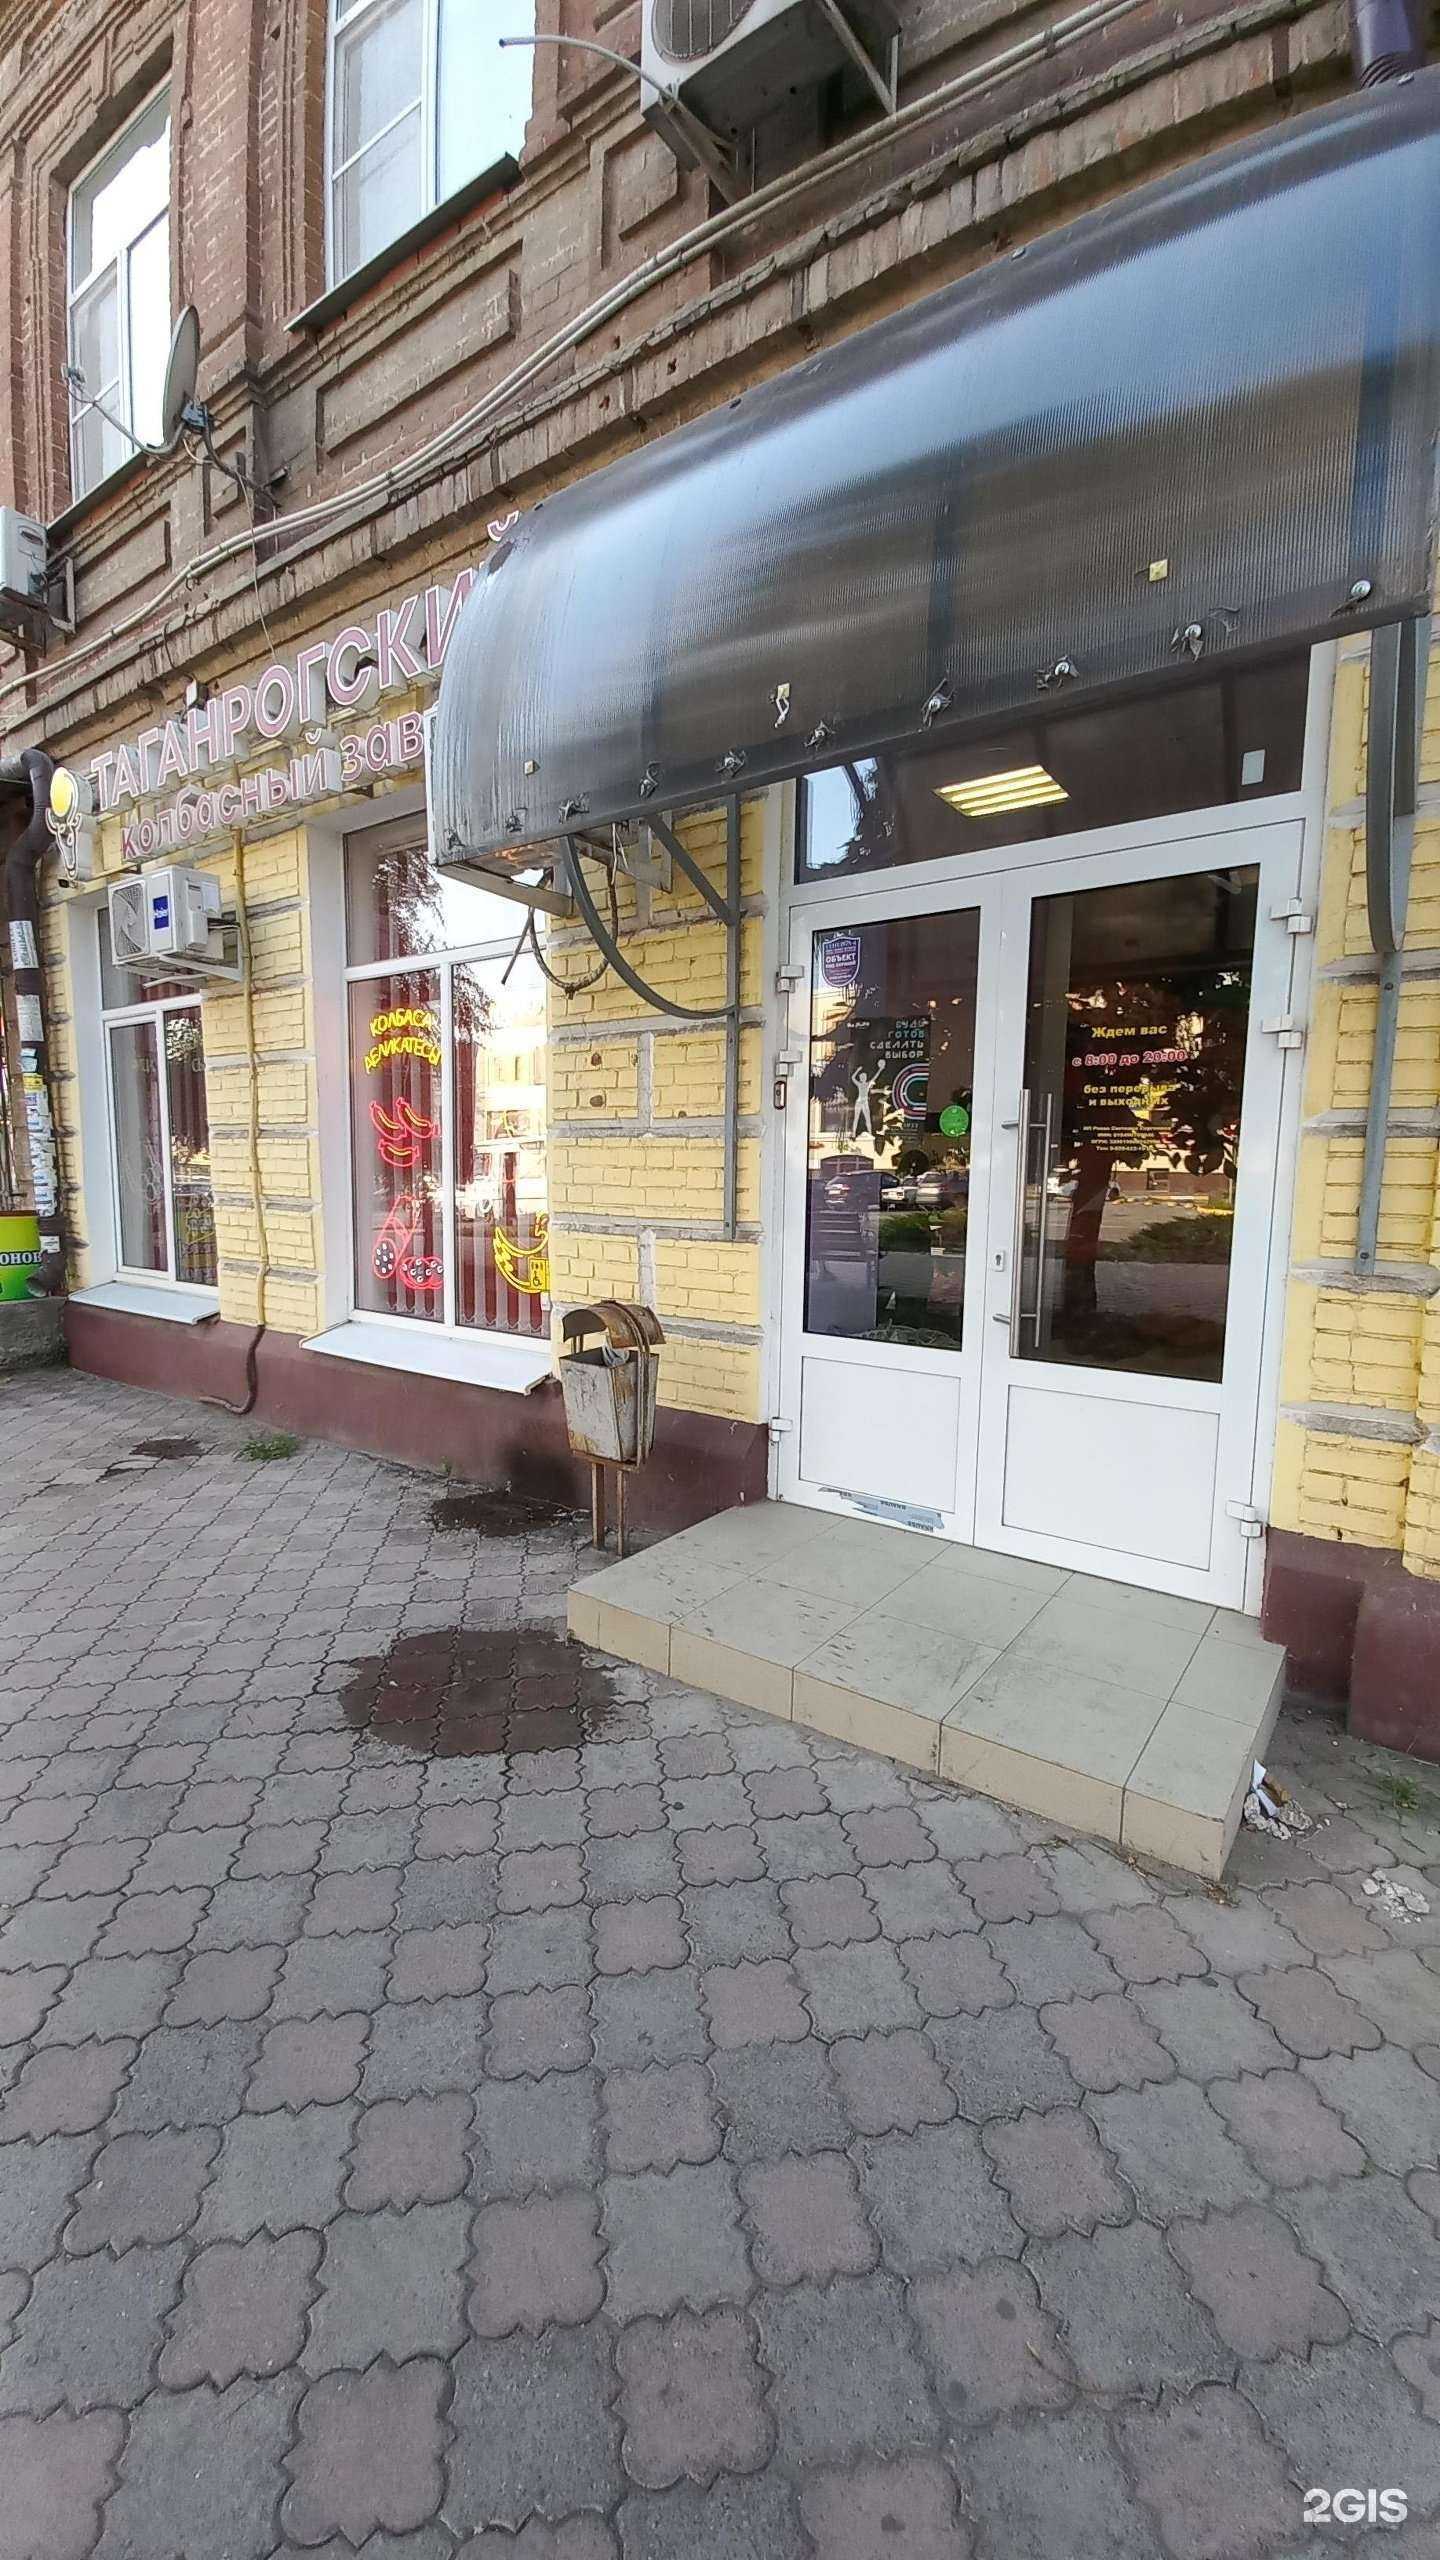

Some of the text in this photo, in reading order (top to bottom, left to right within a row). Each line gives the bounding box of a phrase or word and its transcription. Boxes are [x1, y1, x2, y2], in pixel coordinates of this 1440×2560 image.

[91, 511, 520, 812] ТАГАНРОГСКИ
[340, 711, 425, 783] зав
[825, 953, 856, 963] ОБЪЕКТ
[370, 1008, 432, 1037] КОЛБАСА
[887, 1030, 925, 1038] ГОТОВ
[1091, 1024, 1168, 1038] Ждем вас
[869, 1040, 924, 1050] СДЕЛАТЬ
[364, 1036, 443, 1074] ДЕЛИКАТЕСЫ
[884, 1050, 924, 1059] ВЫБОР
[1084, 1052, 1117, 1067] 8:00
[1119, 1054, 1139, 1066] до
[1142, 1050, 1188, 1064] 20:00
[1083, 1083, 1176, 1095] без перерыва
[1089, 1099, 1097, 1107] и
